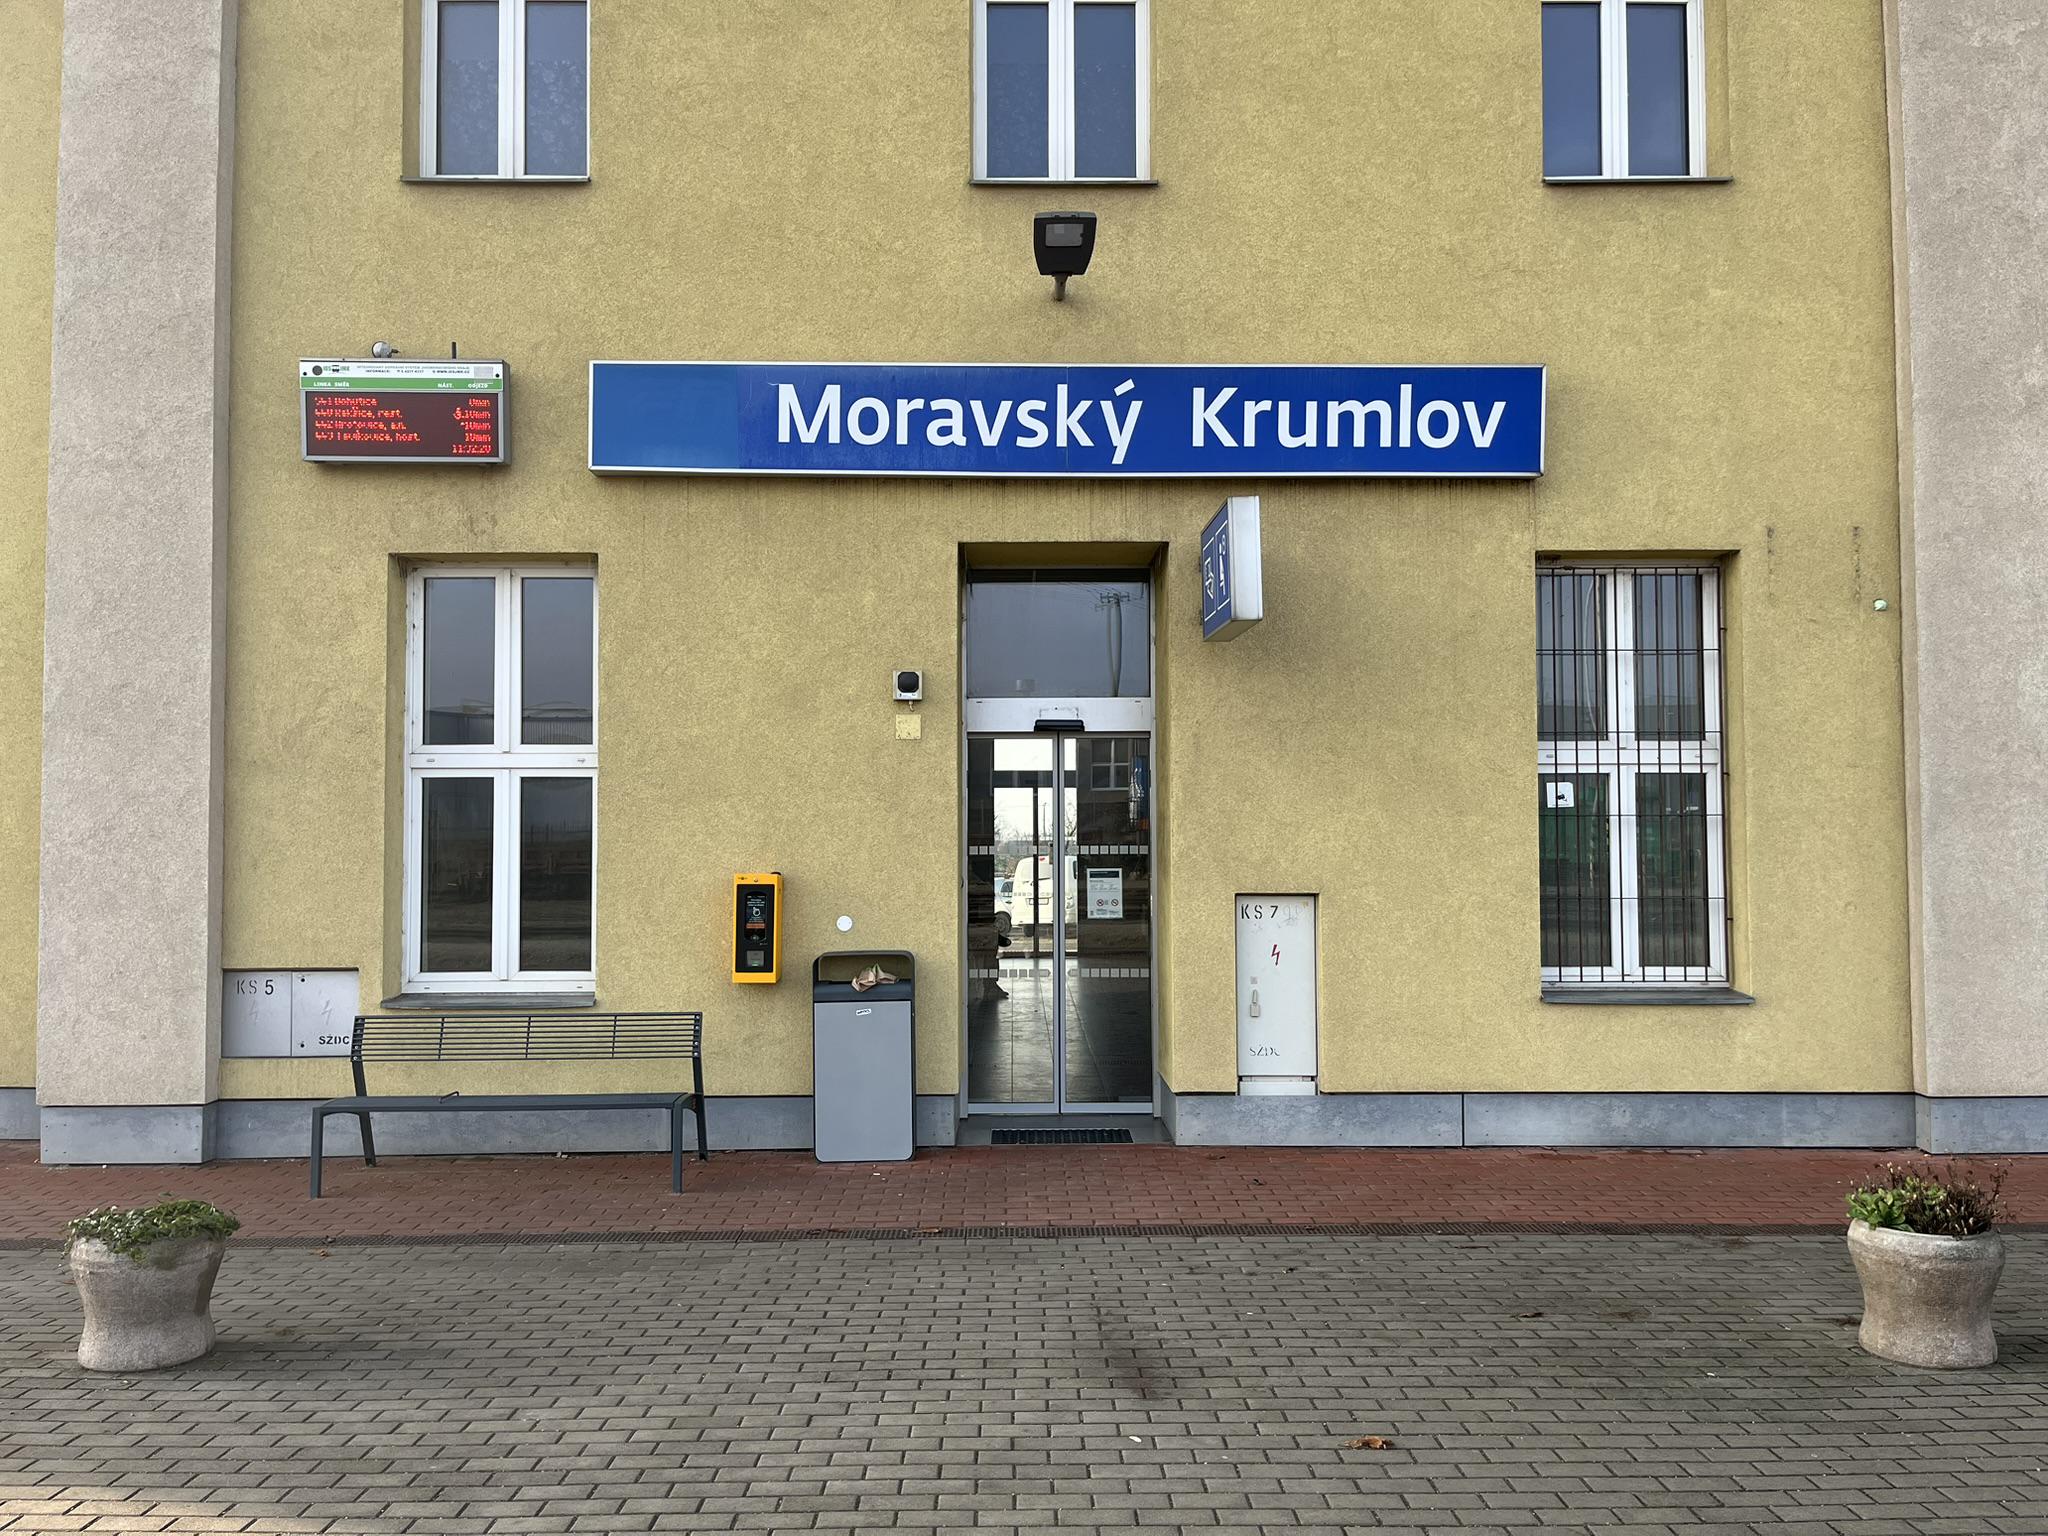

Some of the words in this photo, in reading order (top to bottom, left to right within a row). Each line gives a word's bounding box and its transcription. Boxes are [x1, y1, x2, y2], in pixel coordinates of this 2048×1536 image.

[777, 379, 1143, 464] Moravský
[1191, 384, 1507, 450] Krumlov
[1241, 904, 1263, 920] KS
[1271, 906, 1279, 919] 7
[236, 979, 258, 995] KS
[264, 979, 275, 996] 5
